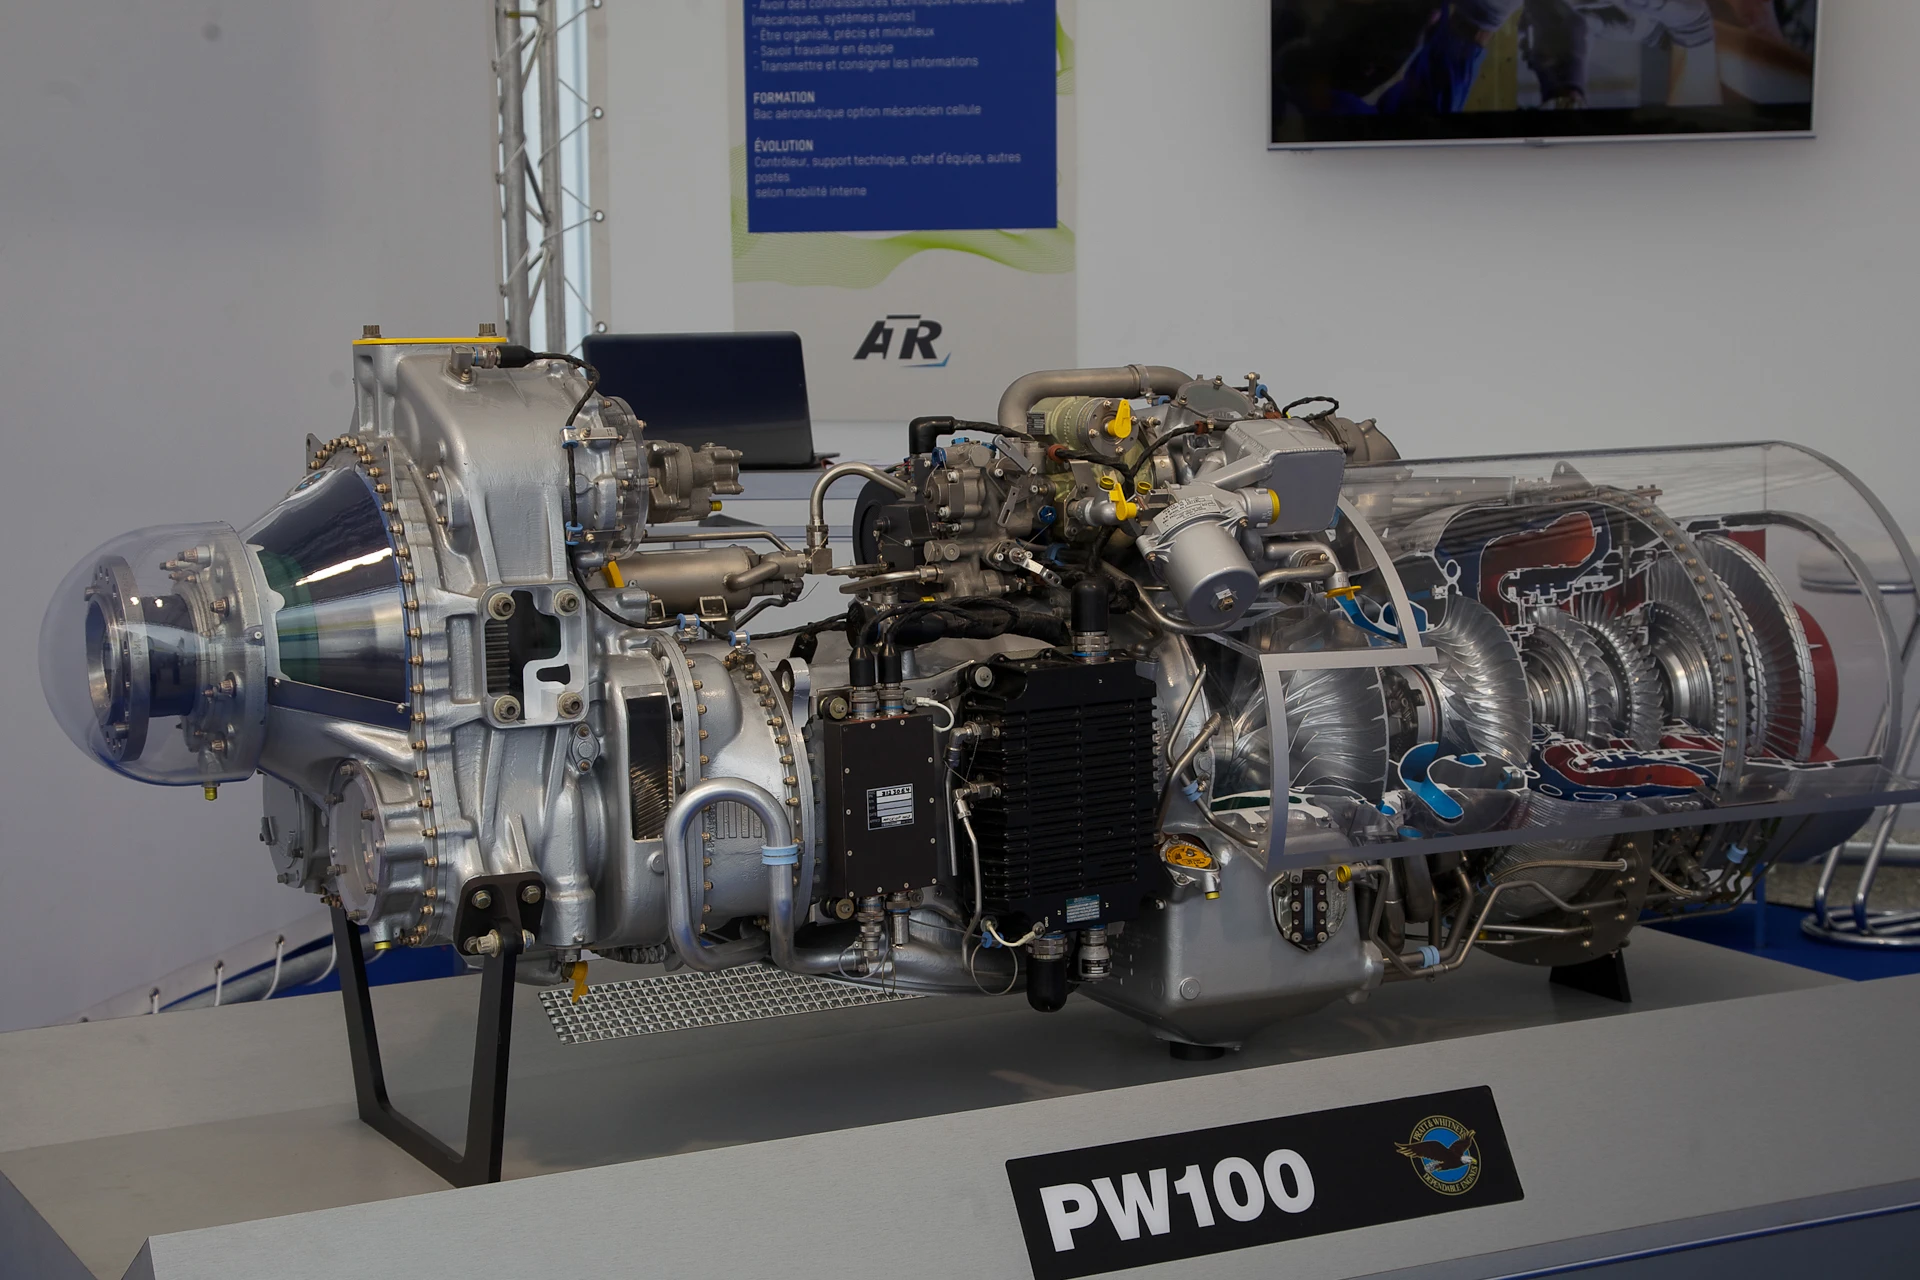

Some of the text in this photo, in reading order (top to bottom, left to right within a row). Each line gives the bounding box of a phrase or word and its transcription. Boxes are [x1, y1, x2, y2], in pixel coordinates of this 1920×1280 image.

[824, 12, 875, 26] systèmes
[760, 28, 781, 41] Être
[783, 29, 832, 42] organisé,
[834, 27, 867, 41] précis
[869, 28, 881, 38] et
[882, 26, 935, 37] minutieux
[760, 45, 792, 57] Savoir
[794, 44, 840, 55] travailler
[842, 45, 856, 55] en
[858, 42, 894, 55] équipe
[761, 60, 823, 71] Transmettre
[825, 60, 837, 71] et
[838, 58, 891, 72] consigner
[893, 57, 909, 69] les
[911, 56, 980, 68] informations
[753, 91, 816, 104] FORMATION
[753, 103, 982, 120] Bac aéronautique option mécanicien cellule
[754, 137, 815, 152] ÉVOLUTION
[754, 156, 810, 168] Contrôleur,
[812, 156, 852, 169] support
[853, 154, 908, 168] technique,
[911, 153, 935, 165] chef
[987, 152, 1022, 164] autres
[754, 172, 790, 185] postes
[755, 185, 868, 198] selon mobilité interne
[853, 314, 943, 360] ATR
[1423, 1165, 1478, 1192] DEPENDABLE ENGINES
[1039, 1148, 1315, 1253] PW100
